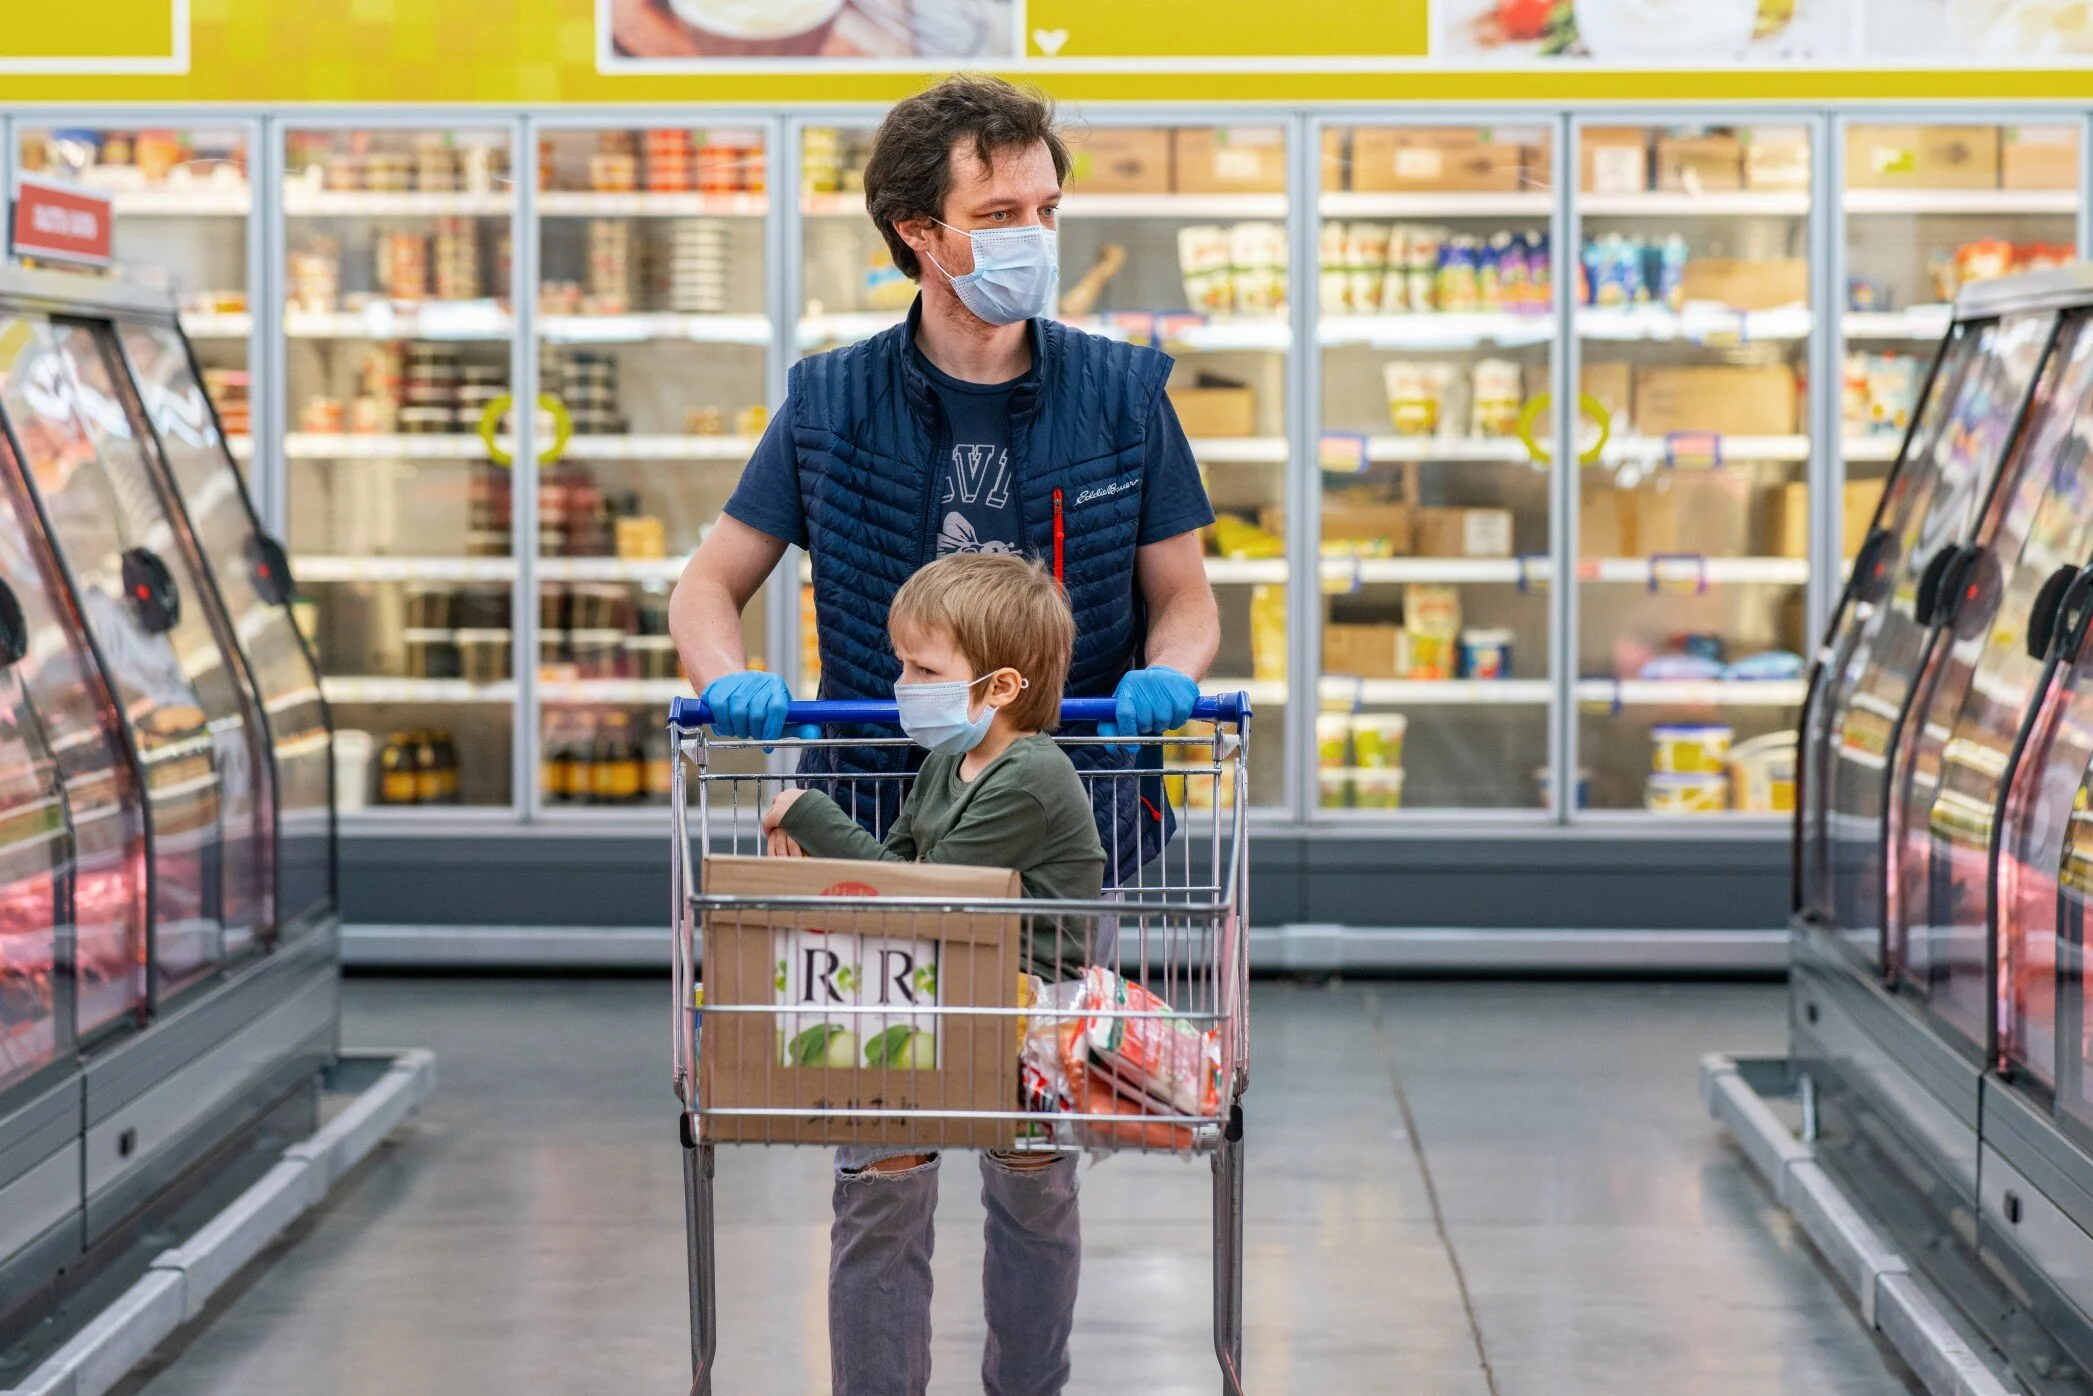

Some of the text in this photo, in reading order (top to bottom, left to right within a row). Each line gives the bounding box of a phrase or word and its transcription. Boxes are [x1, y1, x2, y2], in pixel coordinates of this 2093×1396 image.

[1074, 478, 1140, 507] Eddie Bauer
[803, 948, 919, 1004] R R
